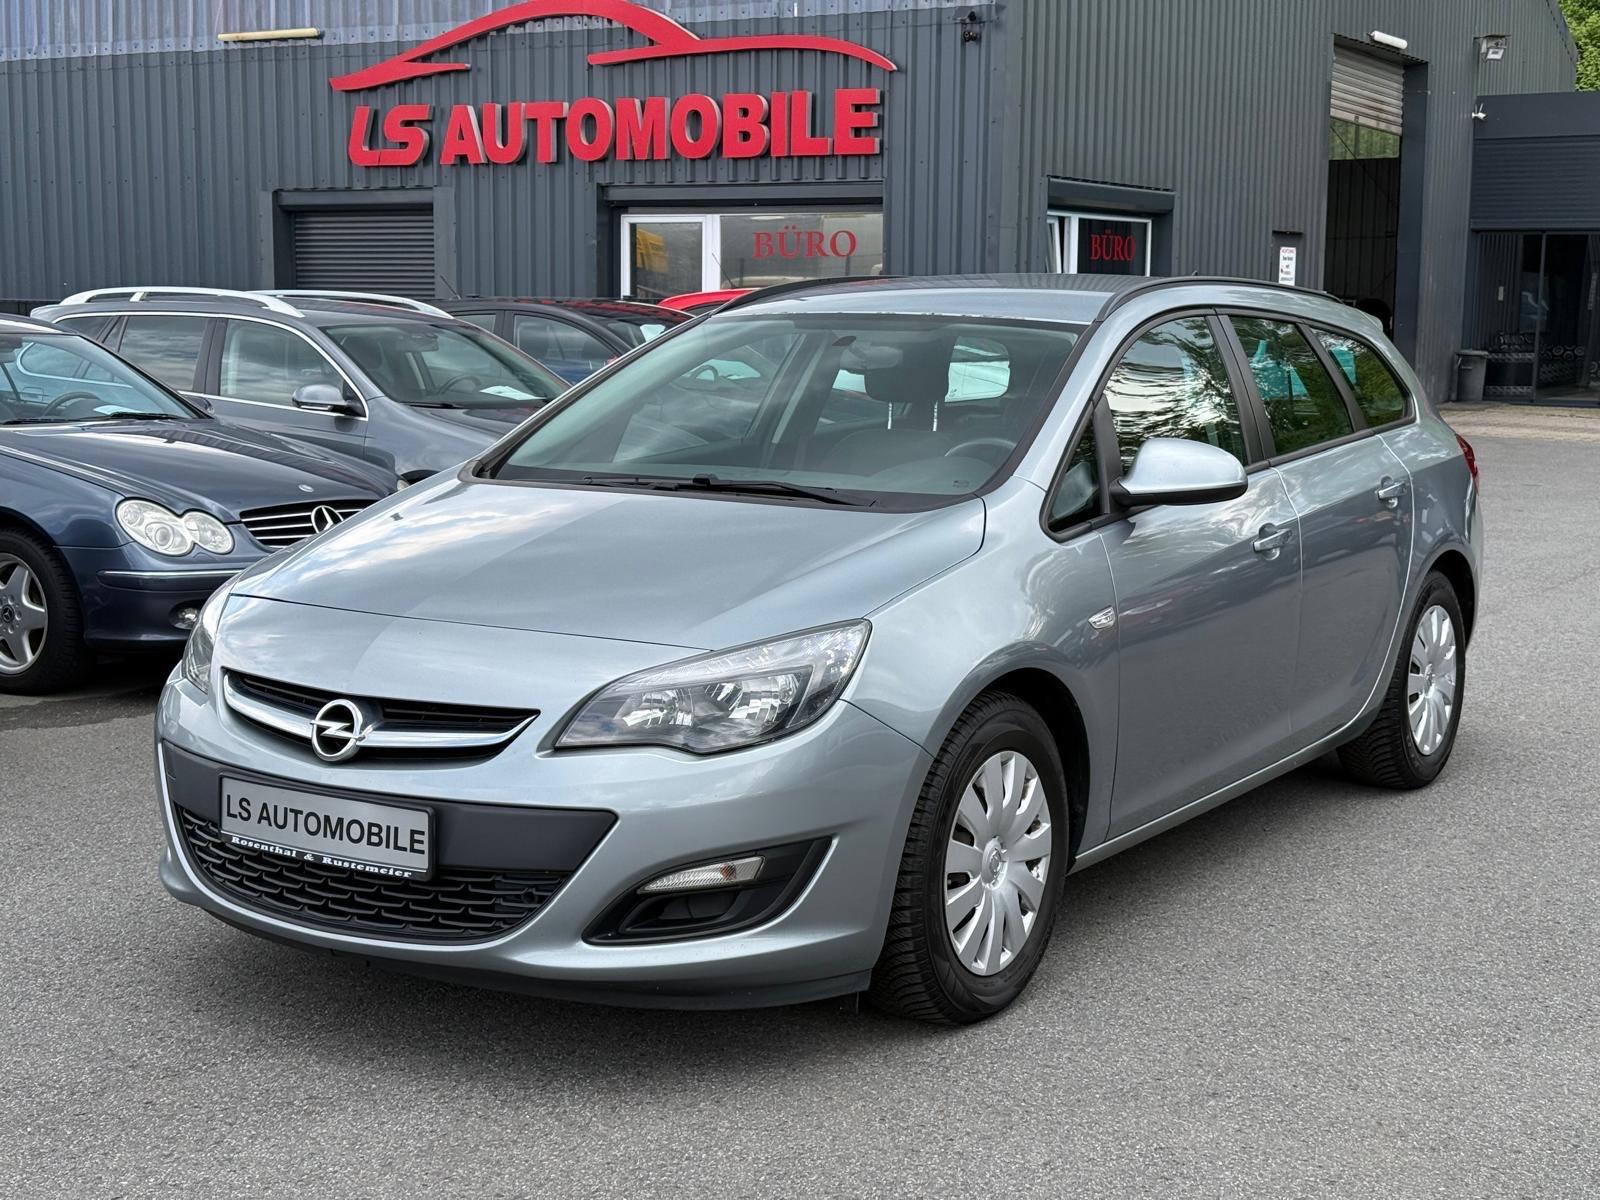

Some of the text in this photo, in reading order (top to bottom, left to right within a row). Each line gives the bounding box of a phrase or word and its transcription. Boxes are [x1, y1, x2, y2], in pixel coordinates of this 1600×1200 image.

[349, 88, 880, 167] LS AUTOMOBILE
[752, 224, 857, 259] BÜRO
[1090, 229, 1137, 261] BÜRO
[226, 794, 426, 855] LS AUTOMOBILE
[231, 836, 412, 878] Rosenthal & Rustemeier
